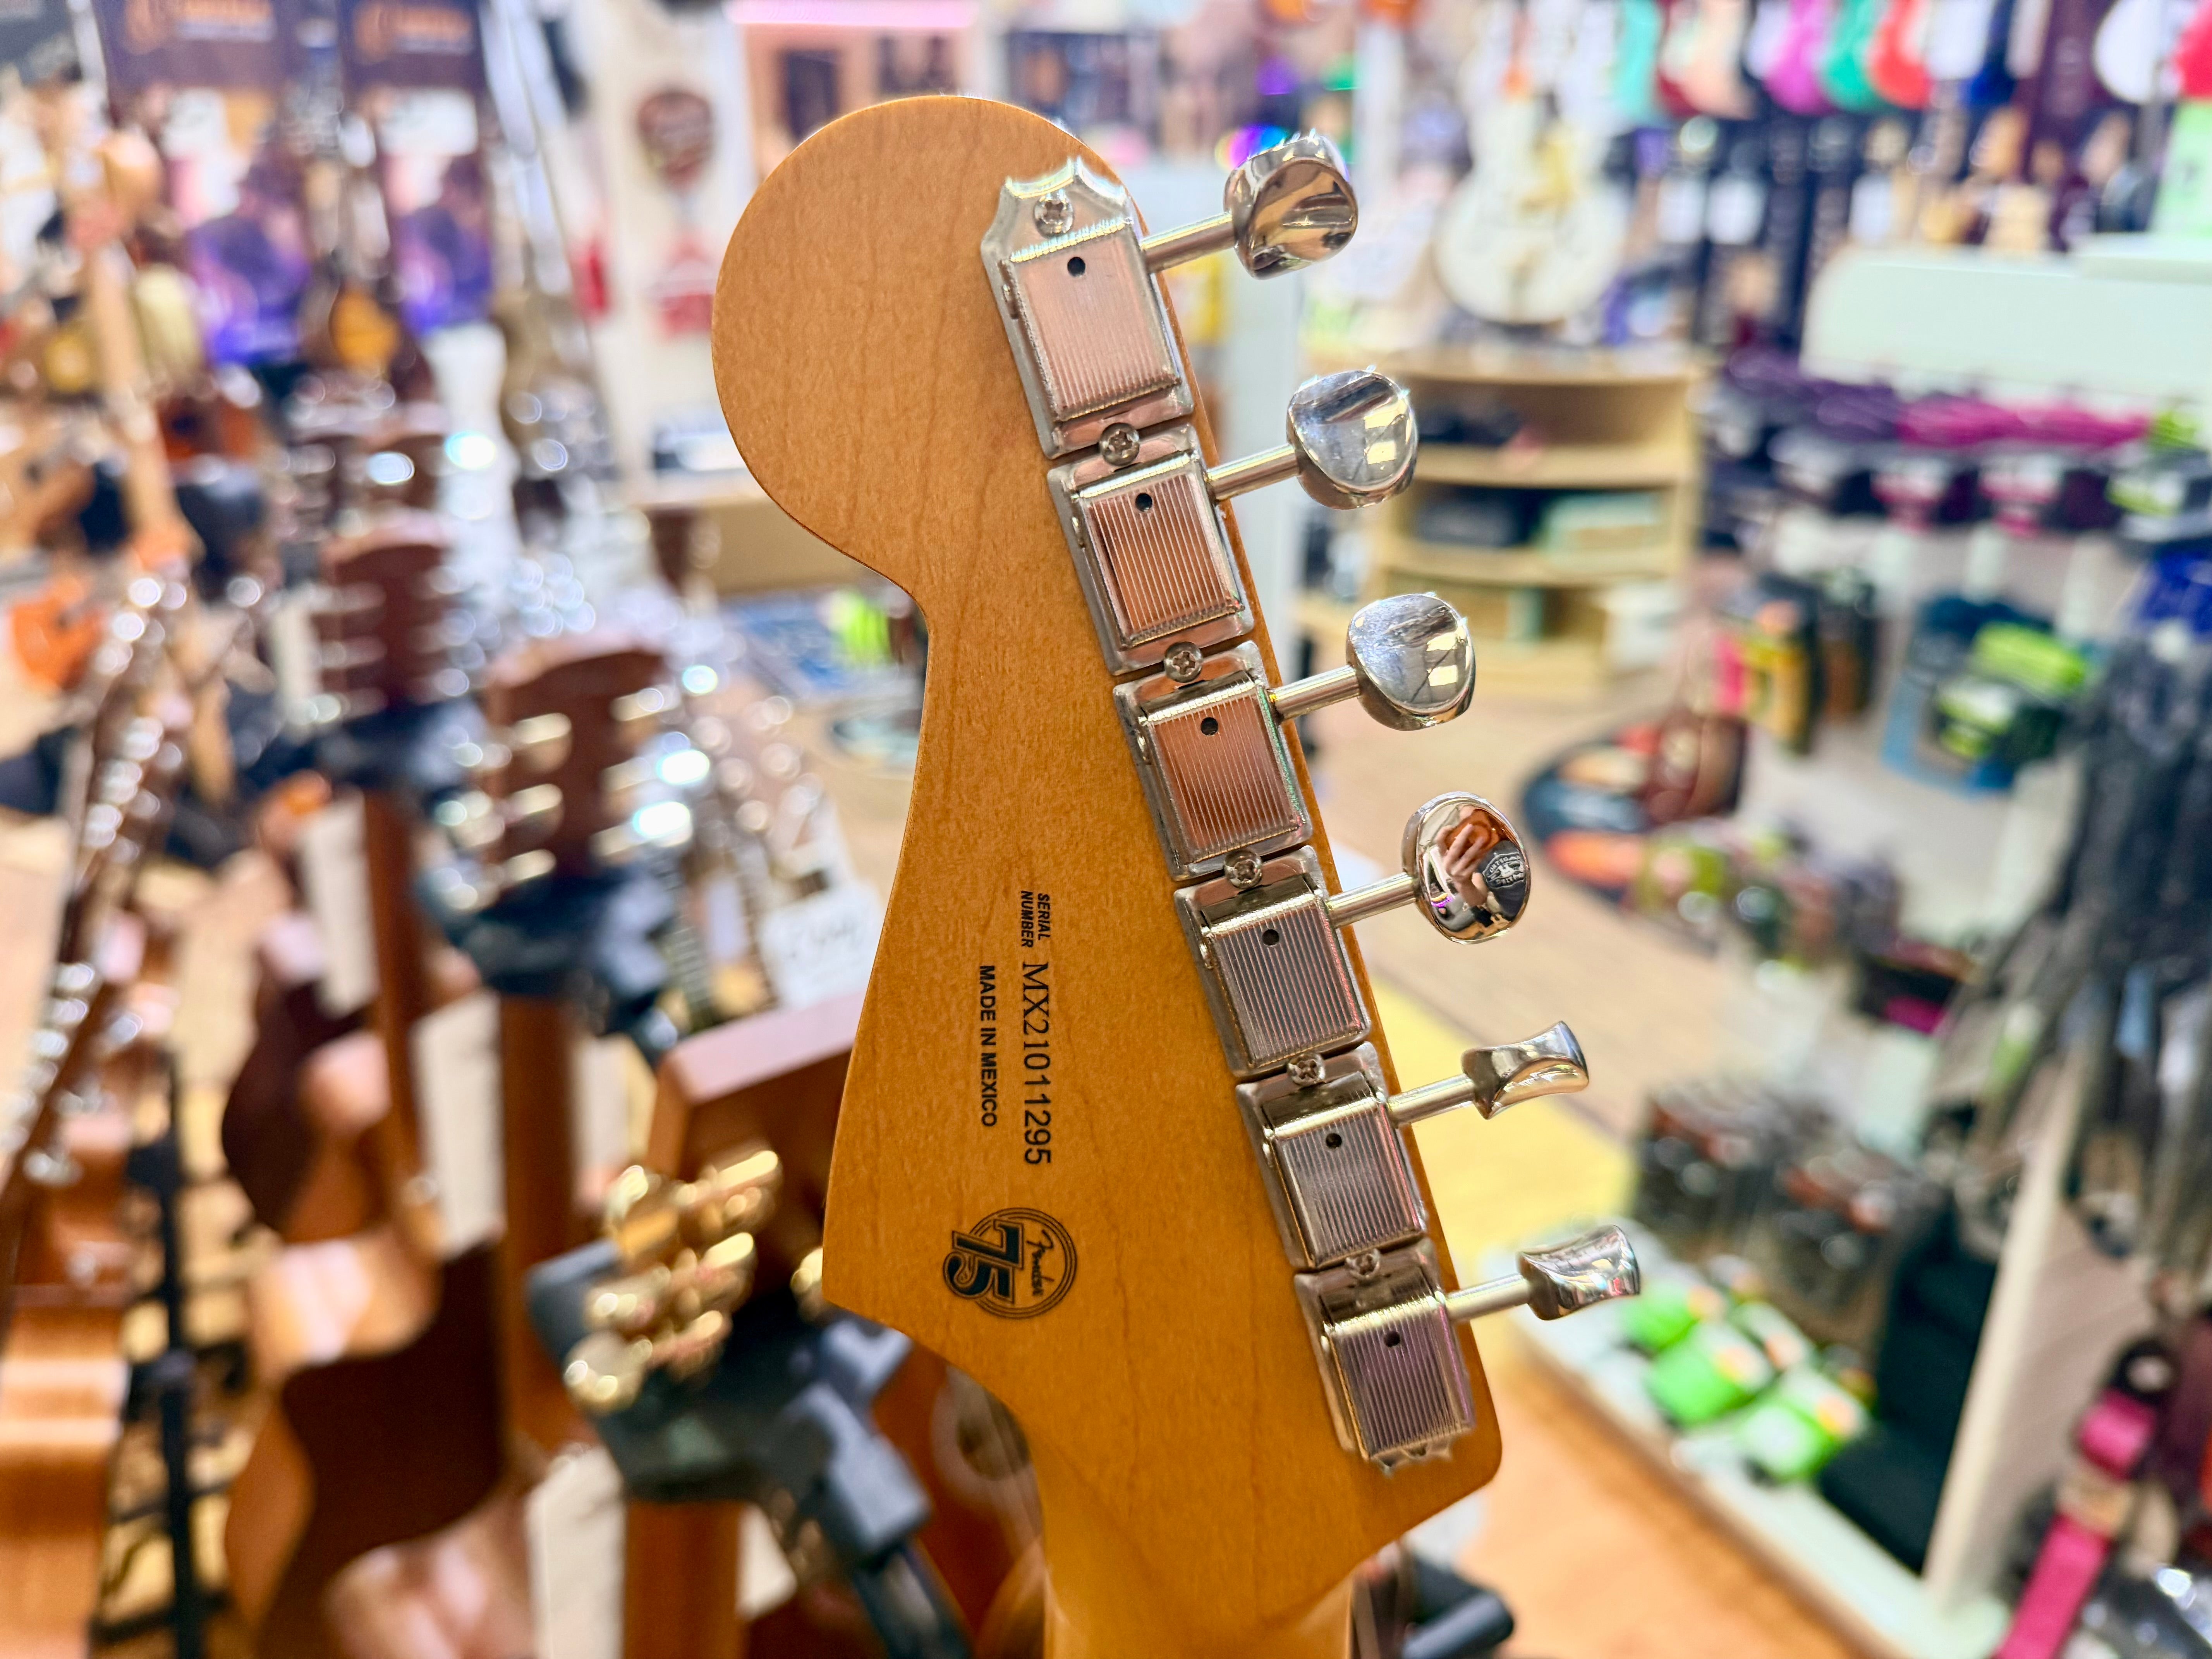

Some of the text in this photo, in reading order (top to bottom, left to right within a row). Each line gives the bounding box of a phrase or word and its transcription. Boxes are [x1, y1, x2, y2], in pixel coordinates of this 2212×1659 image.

[1021, 890, 1034, 948] NUMBER
[1037, 893, 1051, 941] SERIAL
[980, 965, 998, 1127] MADE IN MEXICO
[1022, 962, 1051, 1164] MX21011295
[942, 1219, 1024, 1304] 75
